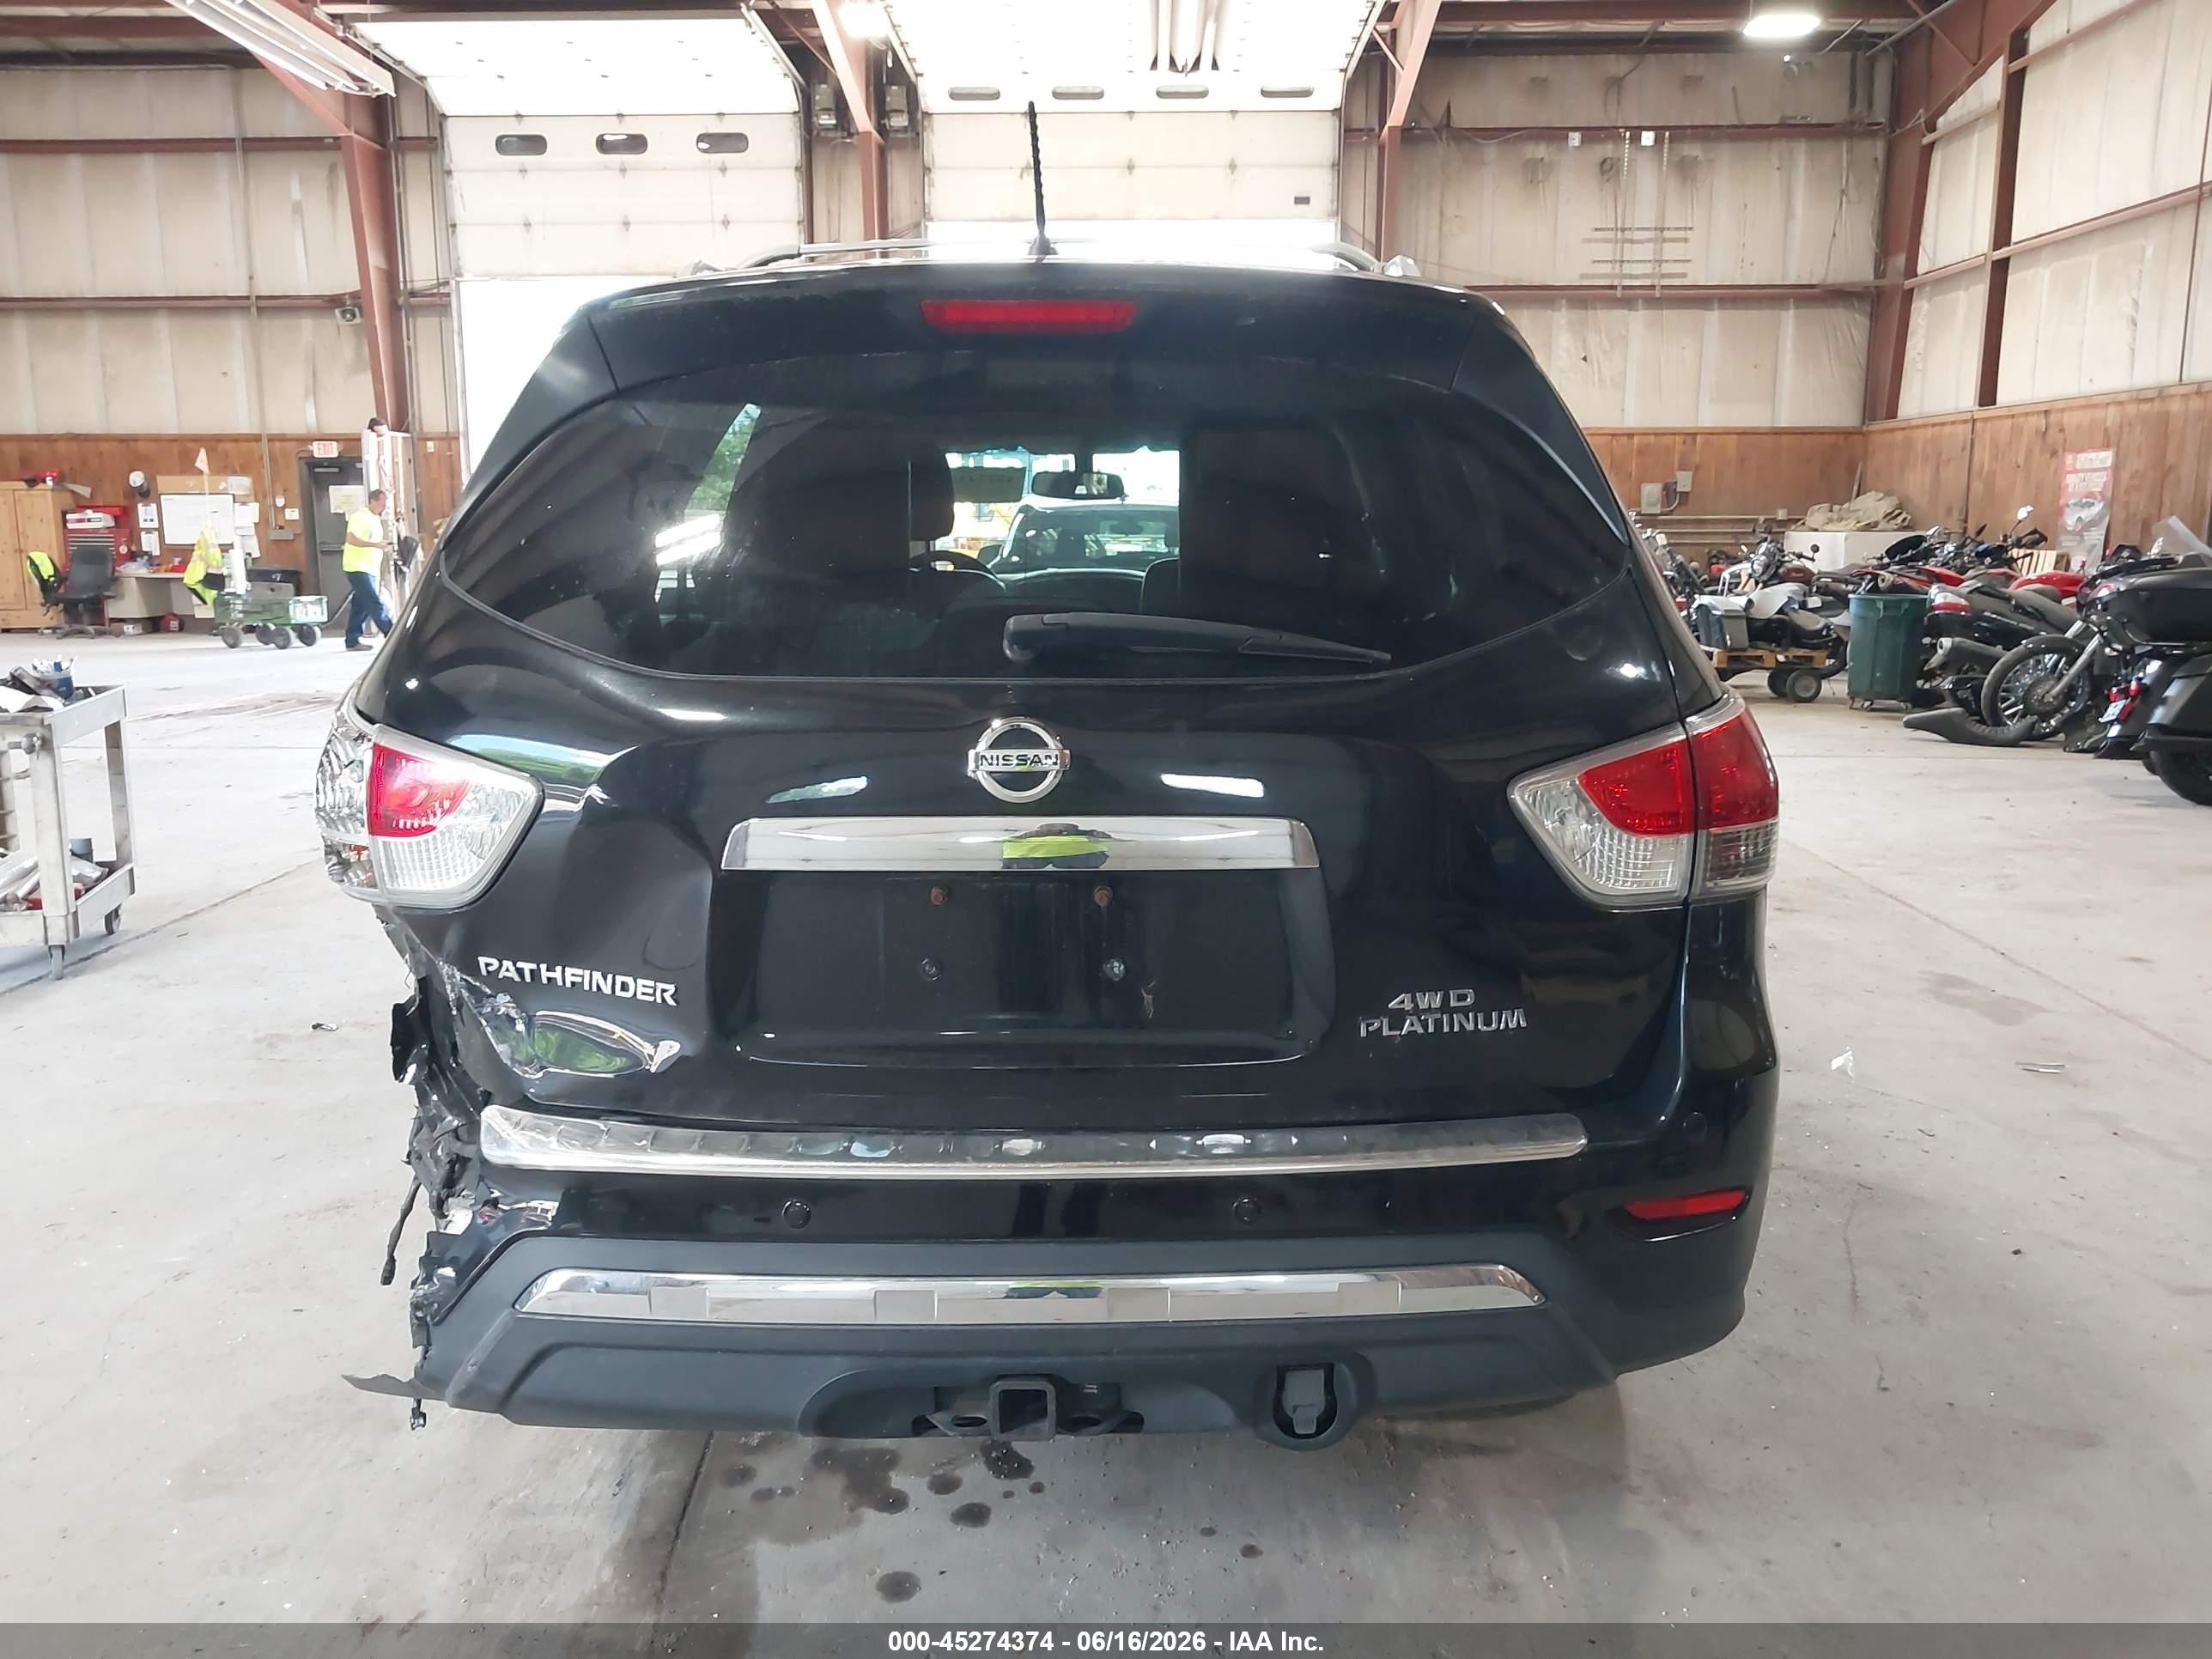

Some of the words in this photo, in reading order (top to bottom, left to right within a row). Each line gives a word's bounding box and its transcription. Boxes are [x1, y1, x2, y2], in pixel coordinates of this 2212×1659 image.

[980, 754, 1059, 767] NISSAN
[477, 956, 679, 1007] PATHFINDER
[1388, 988, 1475, 1011] 4WD
[1359, 1008, 1528, 1038] PLATINUM
